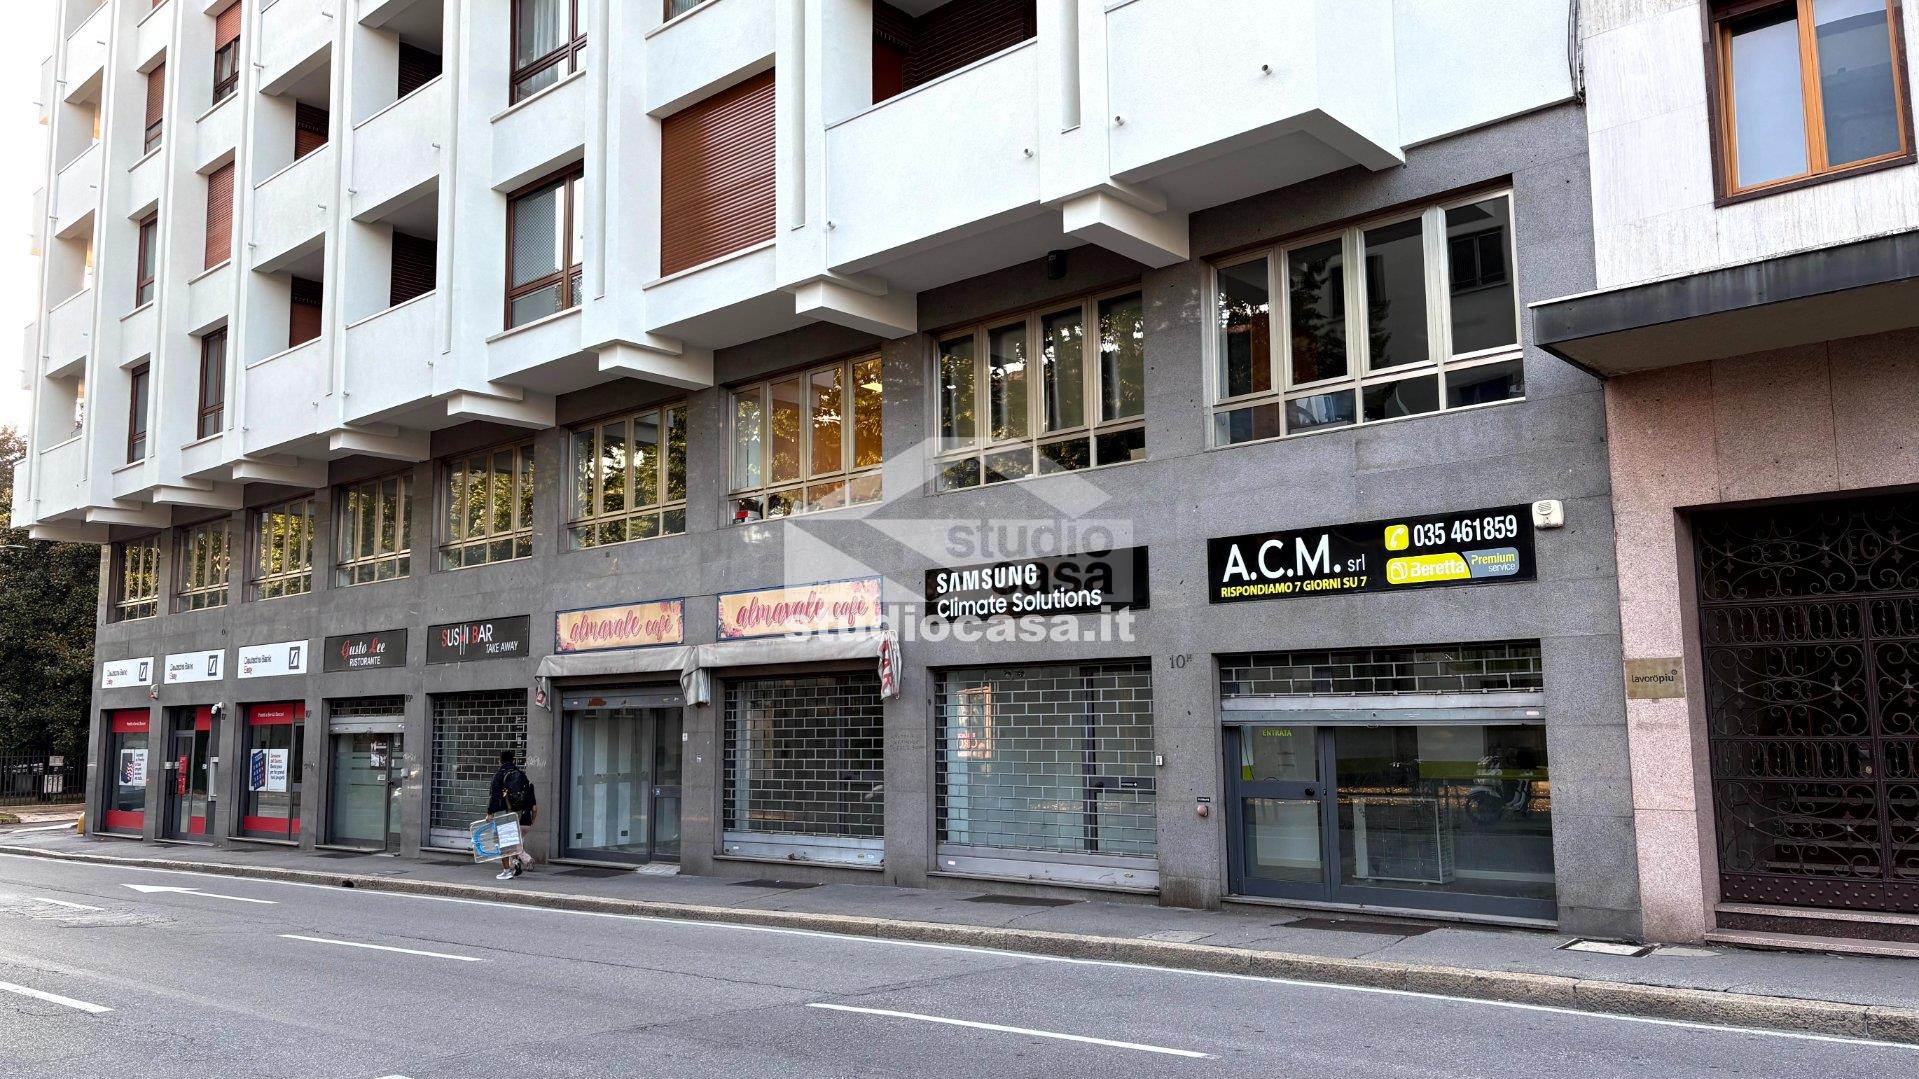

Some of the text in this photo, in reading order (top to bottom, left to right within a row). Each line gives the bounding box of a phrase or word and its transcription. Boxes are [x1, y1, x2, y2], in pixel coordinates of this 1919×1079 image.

[1413, 514, 1518, 547] 035 461859
[1222, 534, 1366, 583] A.C.M. srl
[1410, 559, 1465, 577] Beretta
[1471, 552, 1515, 565] Premium
[1488, 563, 1516, 573] service
[936, 563, 1037, 594] SAMSUNG
[1221, 576, 1368, 598] RISPONDIAMO 7 GIORNI SU 7
[937, 587, 1103, 619] Climate Solutions
[569, 609, 642, 642] almavale
[341, 636, 386, 658] Gusto Lee
[441, 624, 493, 655] SUSHI BAR
[486, 641, 518, 653] TAKE AWAY
[349, 656, 381, 667] RISTORANTE
[1262, 728, 1292, 737] ENTRATA
